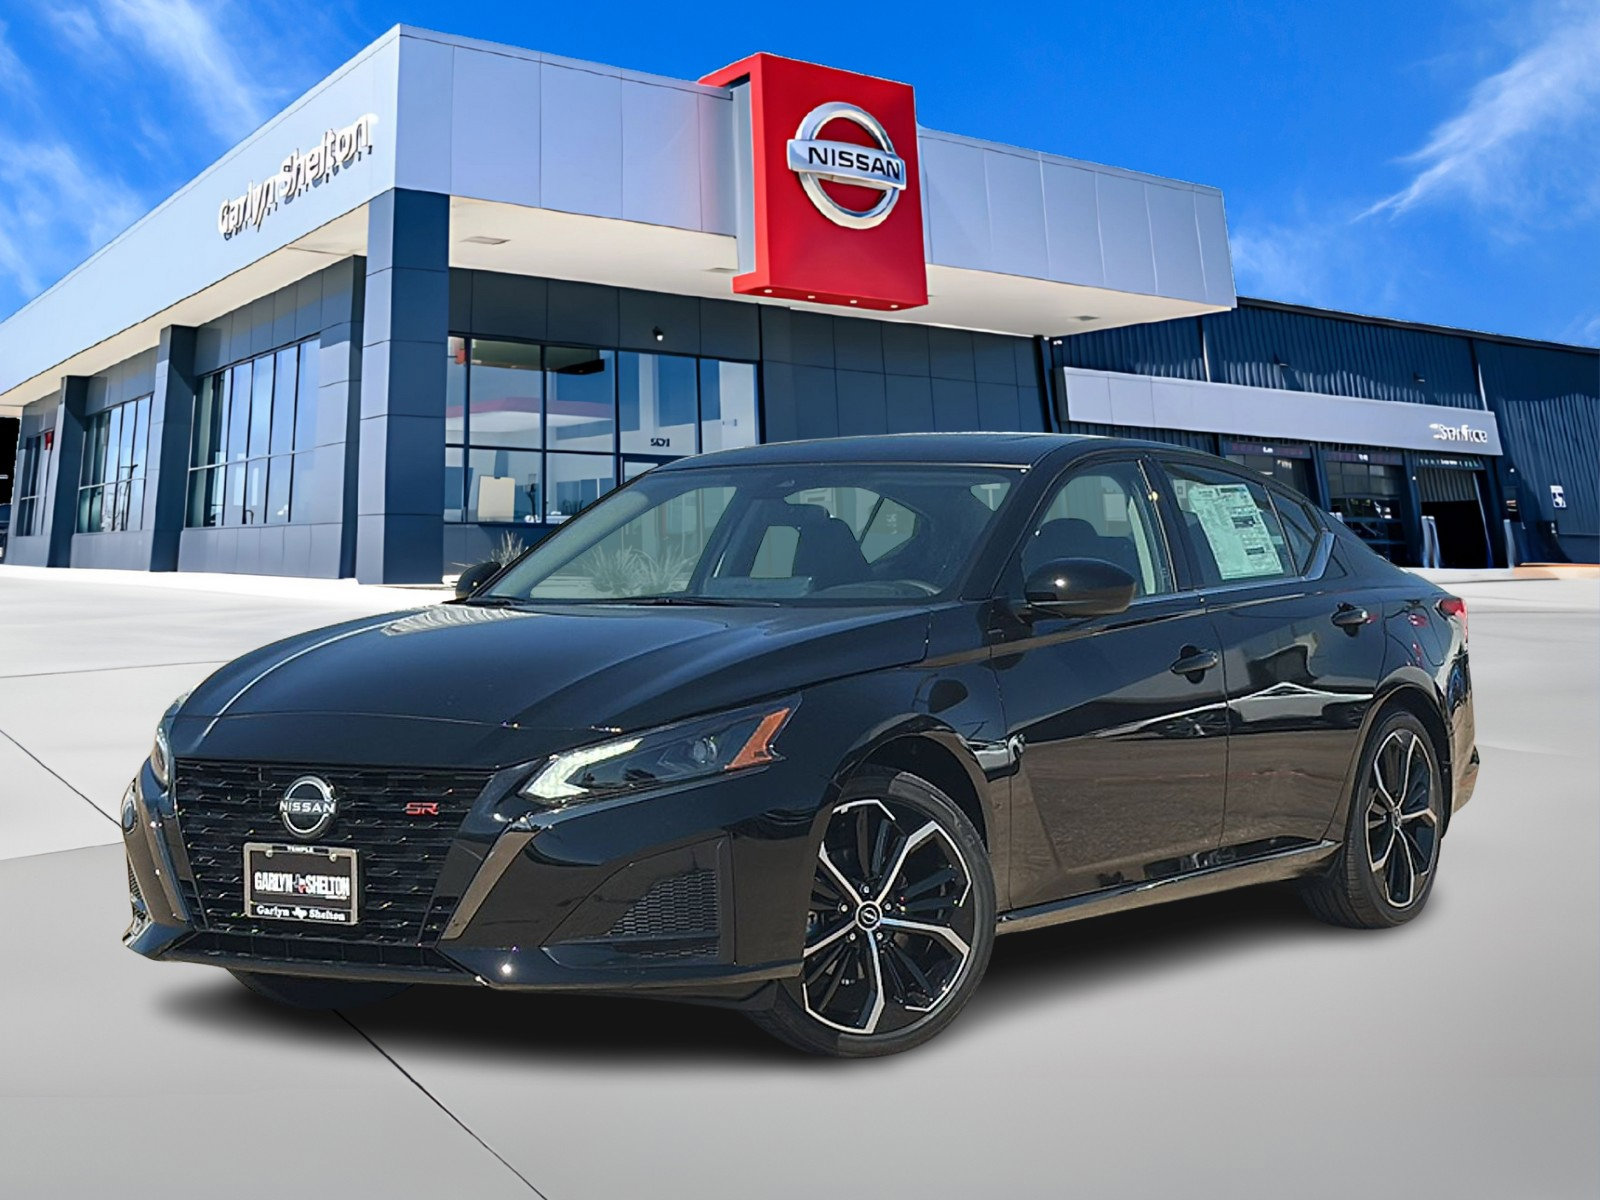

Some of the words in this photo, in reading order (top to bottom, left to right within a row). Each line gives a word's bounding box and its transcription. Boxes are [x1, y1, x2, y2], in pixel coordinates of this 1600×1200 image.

[279, 113, 376, 202] Shelton
[808, 146, 900, 180] NISSAN
[279, 799, 336, 814] NISSAN
[405, 802, 439, 815] SR
[254, 871, 293, 892] GARLYN
[305, 875, 350, 897] SHELTON
[256, 905, 290, 918] Garlyn
[309, 908, 346, 921] Shelton
